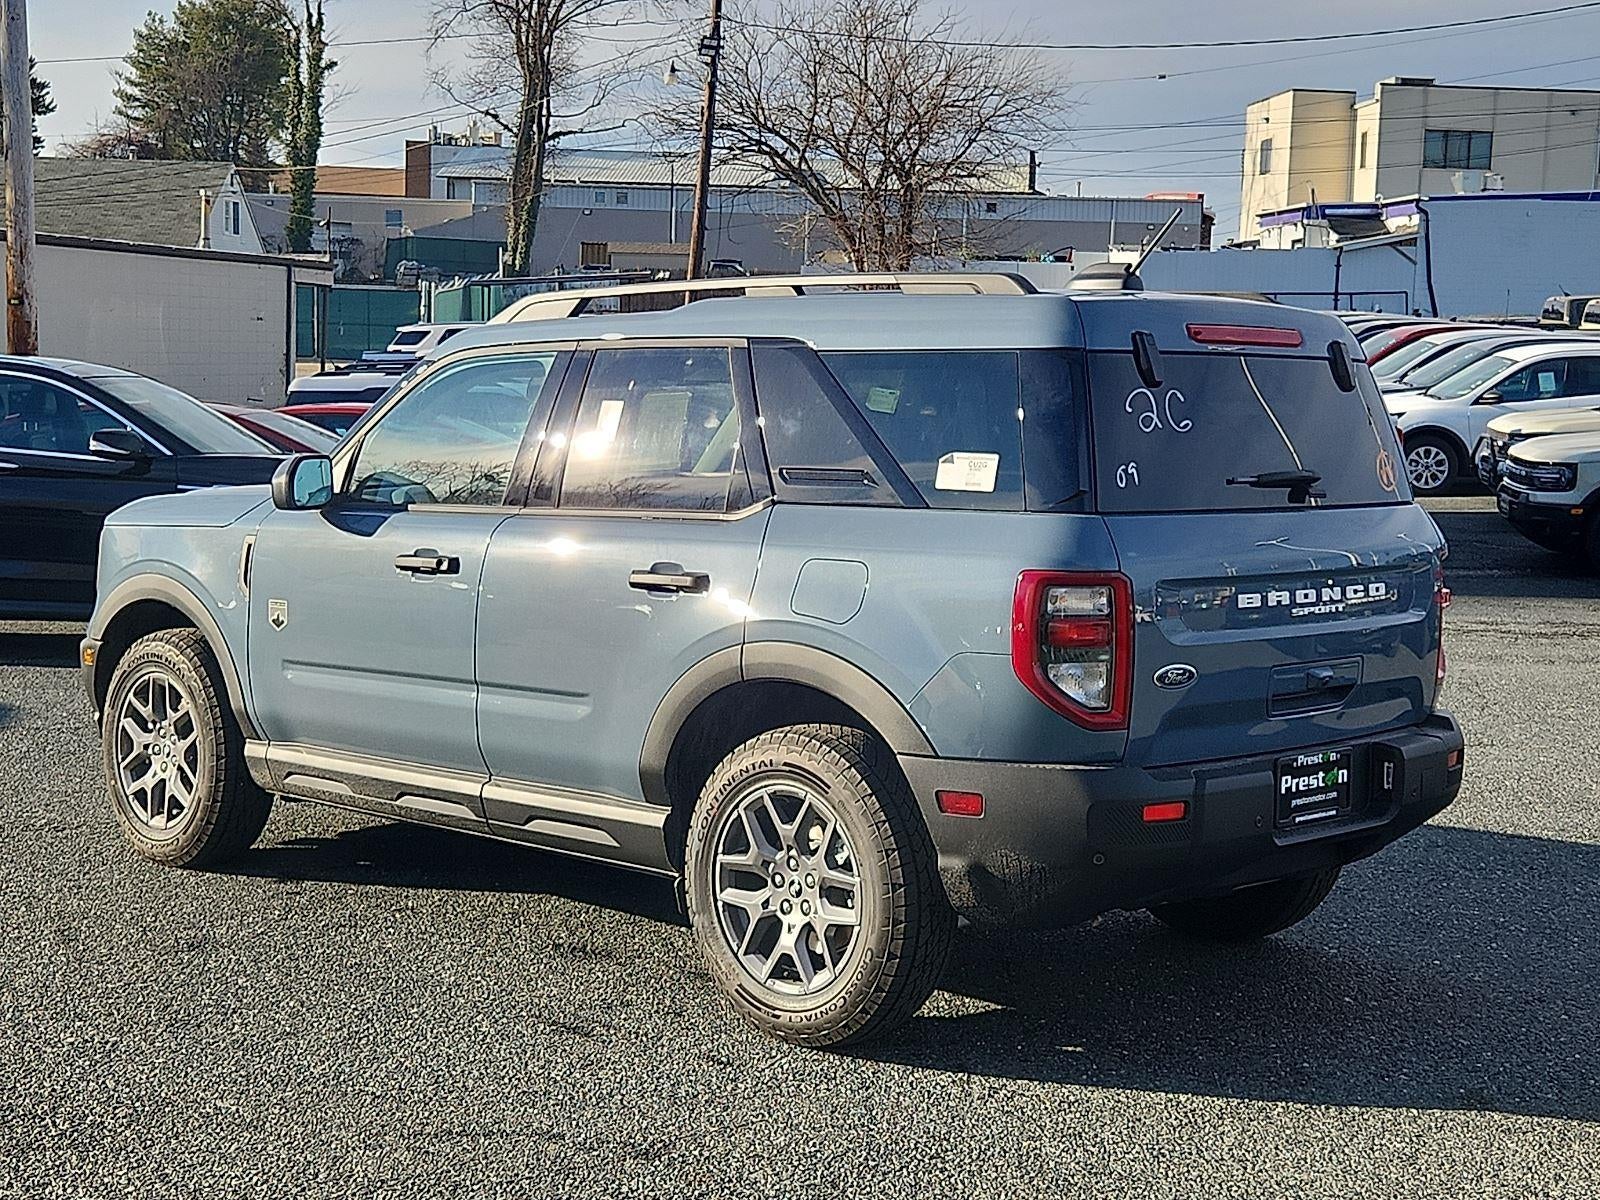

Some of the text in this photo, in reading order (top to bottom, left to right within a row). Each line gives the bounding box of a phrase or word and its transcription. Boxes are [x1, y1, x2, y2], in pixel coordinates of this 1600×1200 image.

[1237, 582, 1386, 609] BRONCO
[1290, 603, 1346, 617] SPORT
[698, 758, 775, 842] CONTINENTAL
